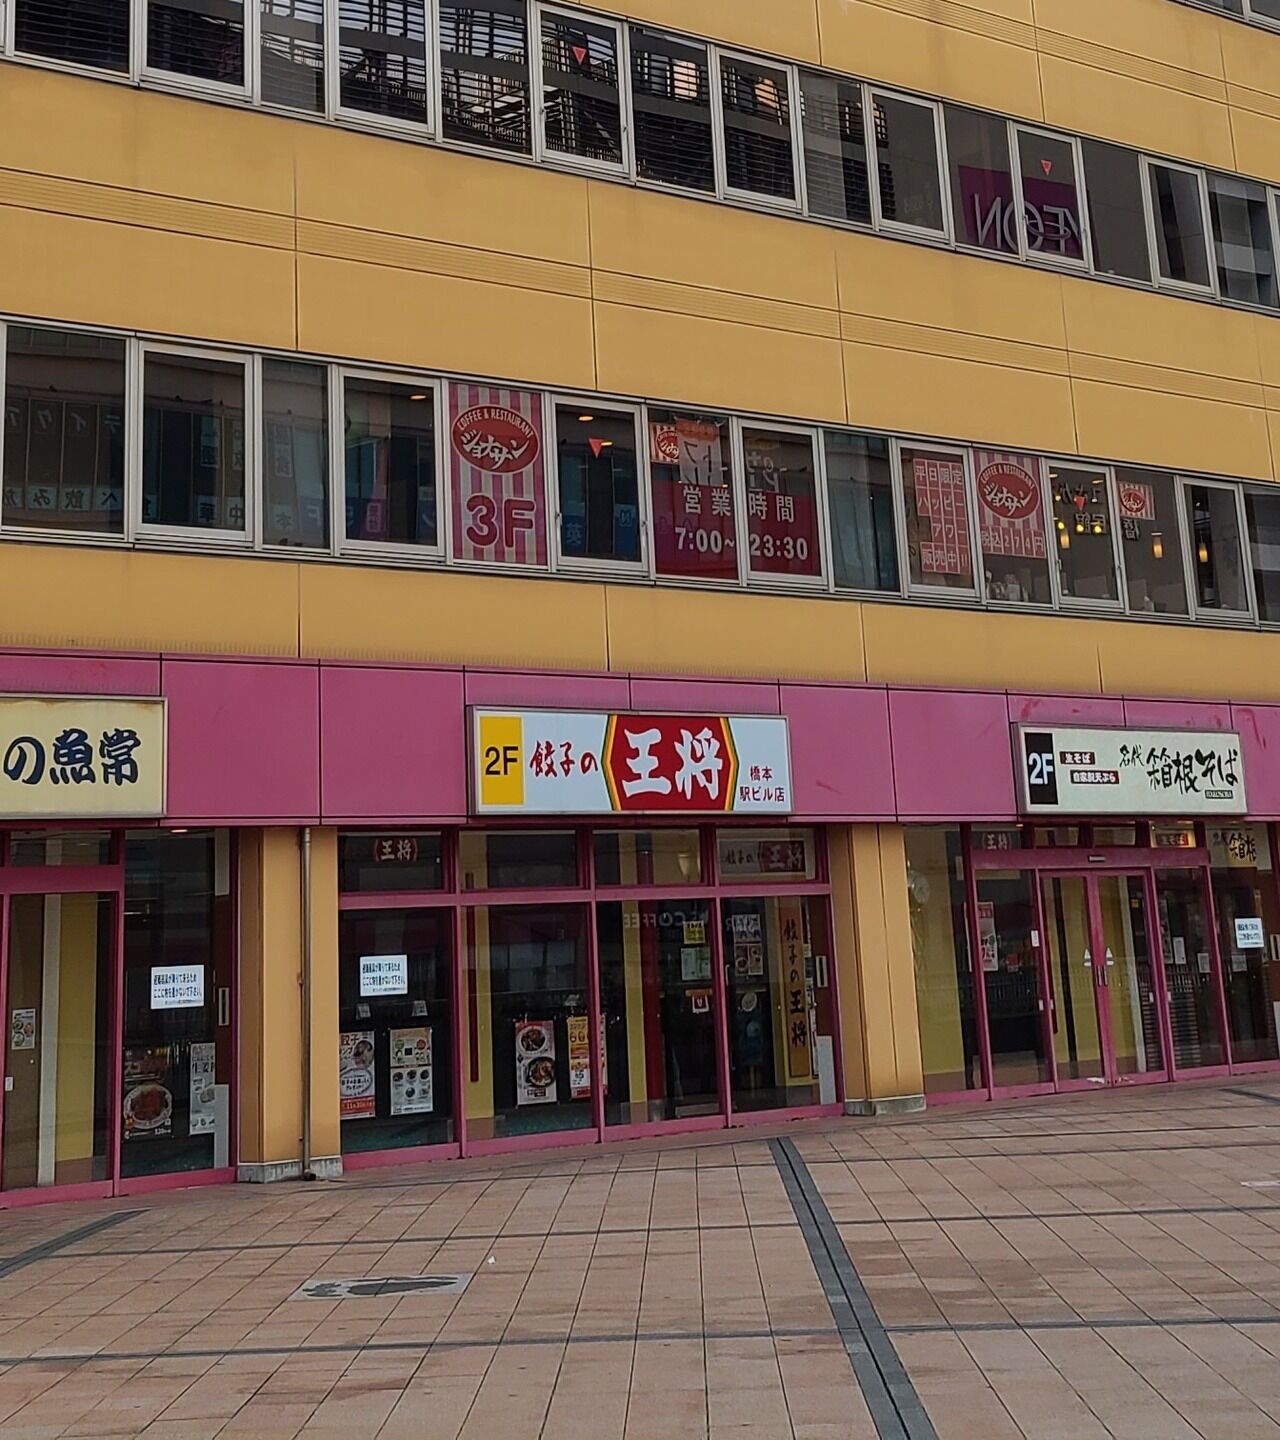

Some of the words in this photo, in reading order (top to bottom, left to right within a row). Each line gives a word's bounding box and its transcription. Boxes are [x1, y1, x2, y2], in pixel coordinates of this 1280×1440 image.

[457, 410, 482, 431] COFFEE
[490, 407, 534, 439] RESTAURANT
[915, 465, 963, 486] 平日限定
[682, 485, 795, 524] 営業時間
[918, 492, 965, 512] ハッピー
[465, 493, 537, 550] 3F
[932, 522, 966, 540] アワー
[484, 746, 519, 776] 2F
[529, 739, 599, 779] 餃子の
[621, 726, 724, 801] 王将
[749, 765, 773, 782] 橋本
[1028, 752, 1054, 786] 2F
[1146, 747, 1240, 795] 箱根そば
[739, 785, 786, 802] 駅ビル店
[380, 838, 412, 861] 王将
[783, 919, 808, 1048] 餃子の王将
